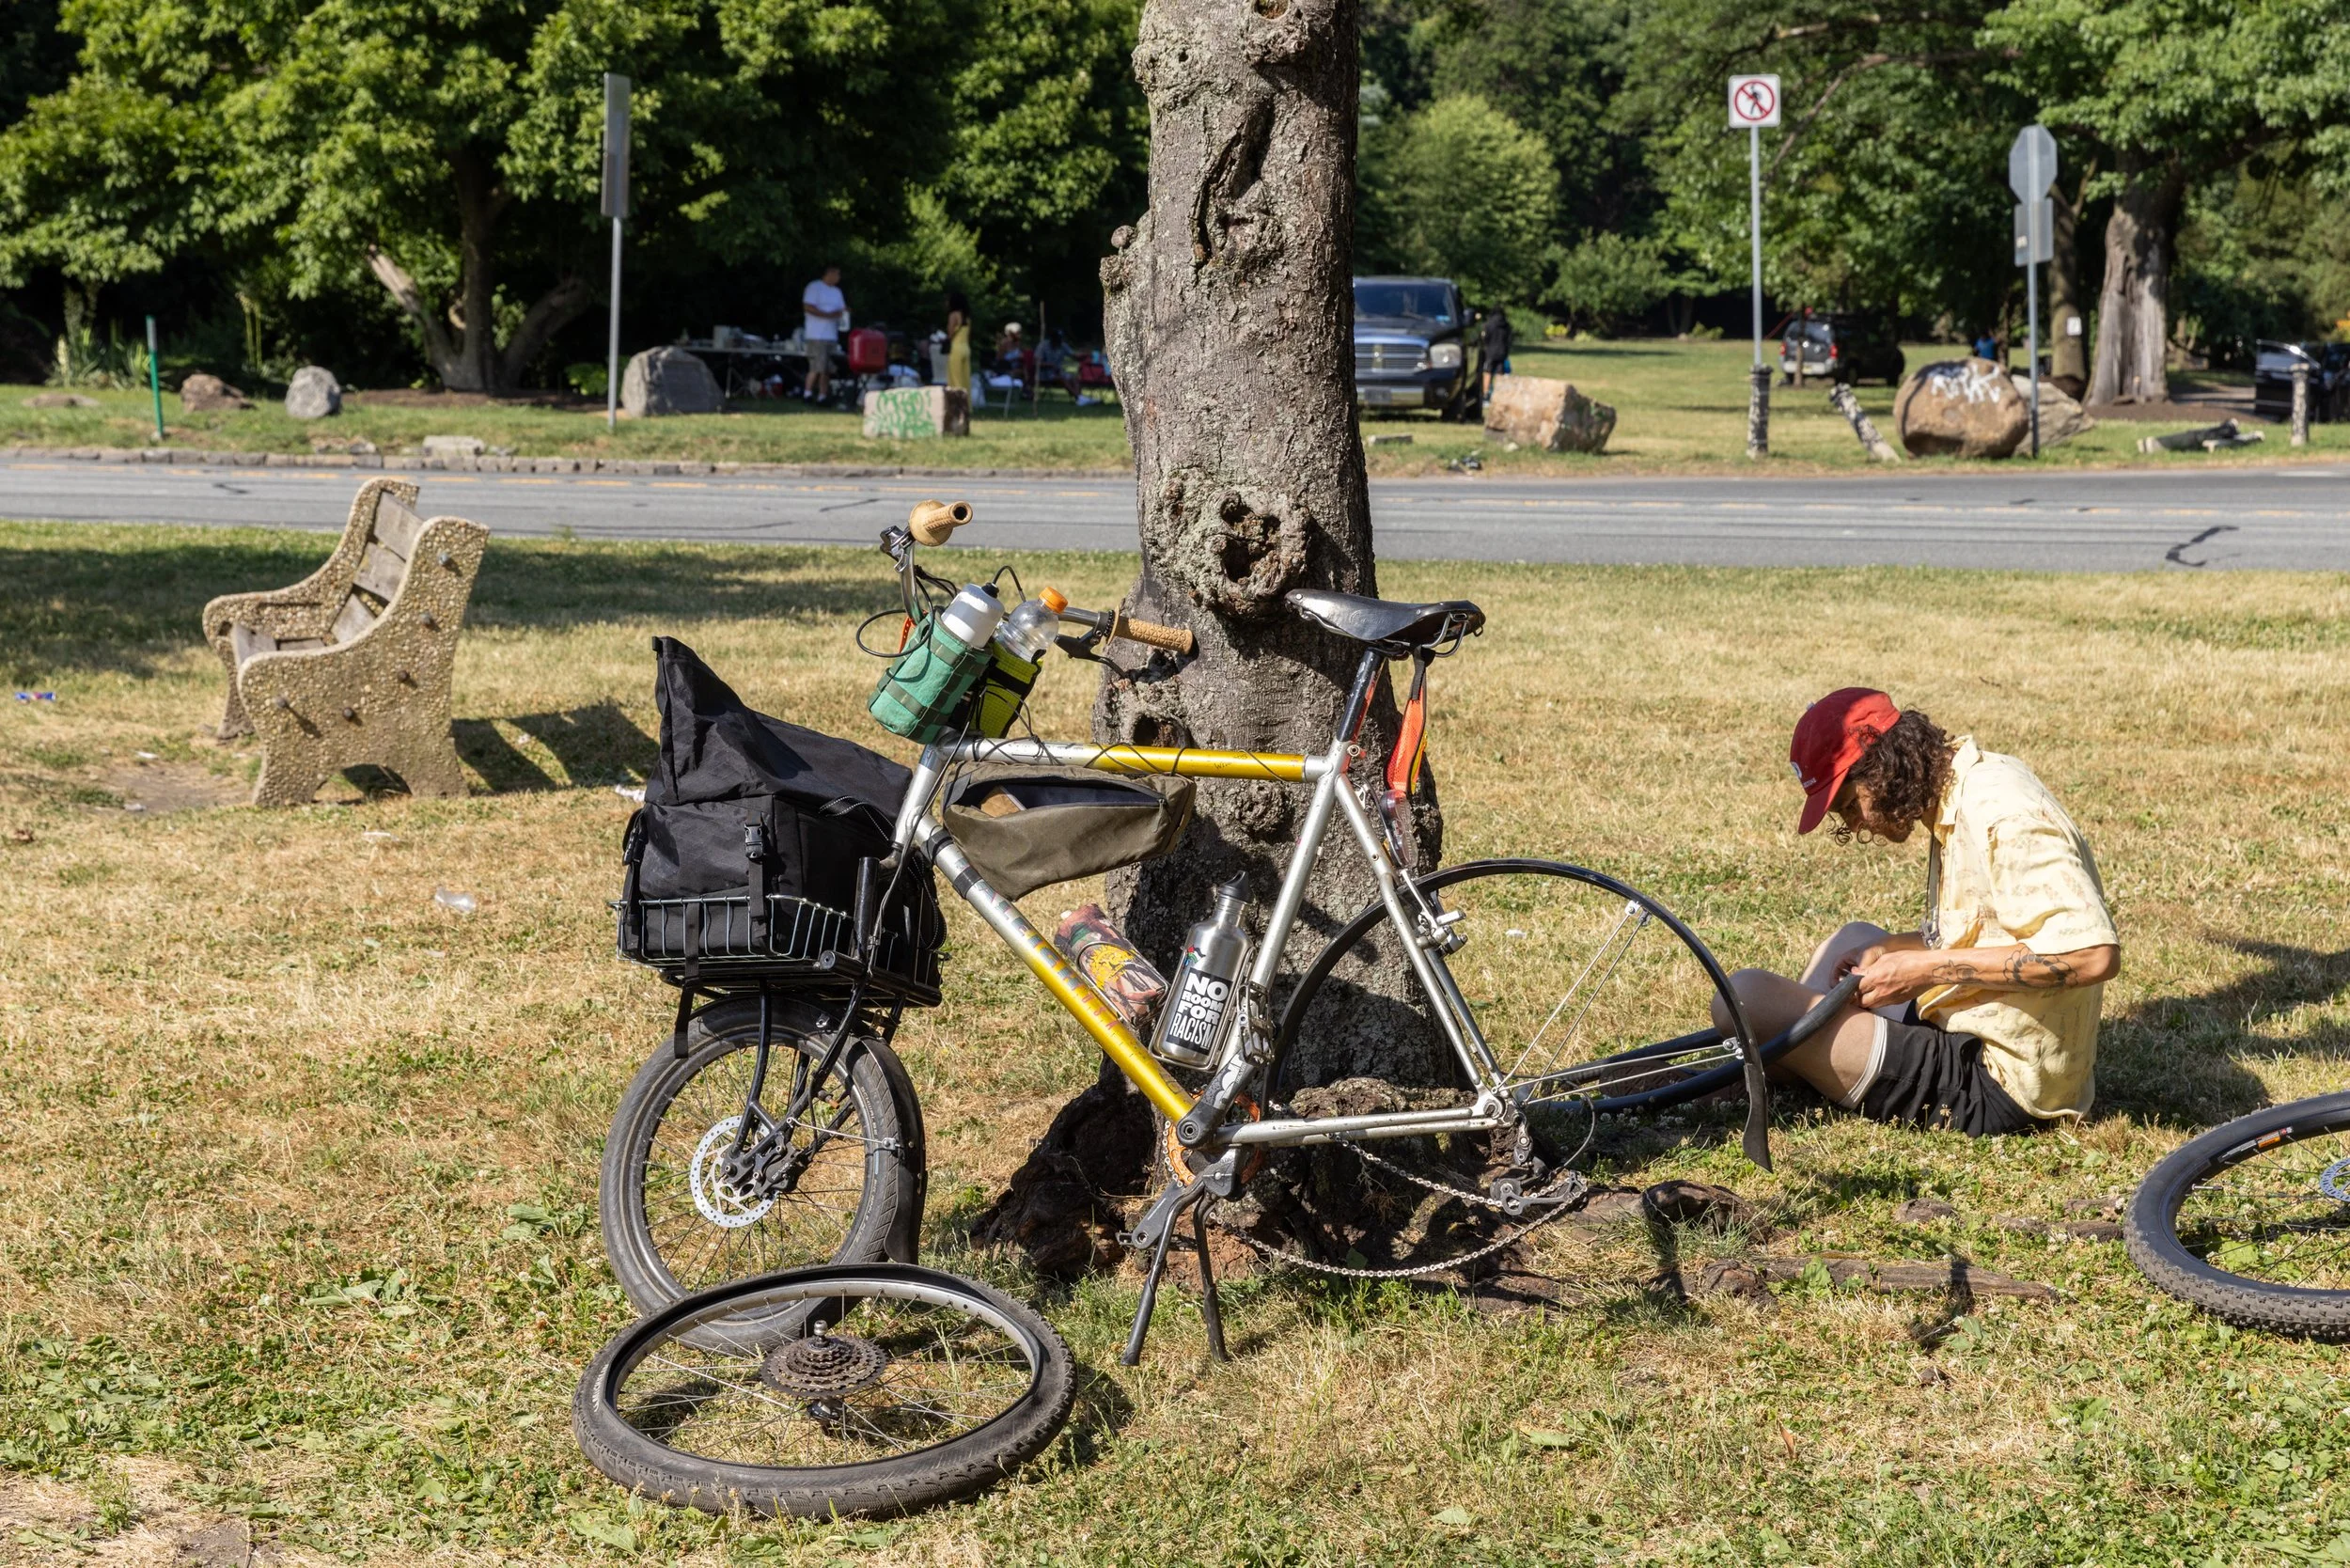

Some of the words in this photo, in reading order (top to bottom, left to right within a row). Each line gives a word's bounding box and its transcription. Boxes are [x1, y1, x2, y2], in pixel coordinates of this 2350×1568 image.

[1183, 972, 1229, 1001] NO
[1177, 999, 1220, 1026] FOR
[1181, 990, 1224, 1012] ROOM
[1168, 1011, 1217, 1048] RACISM
